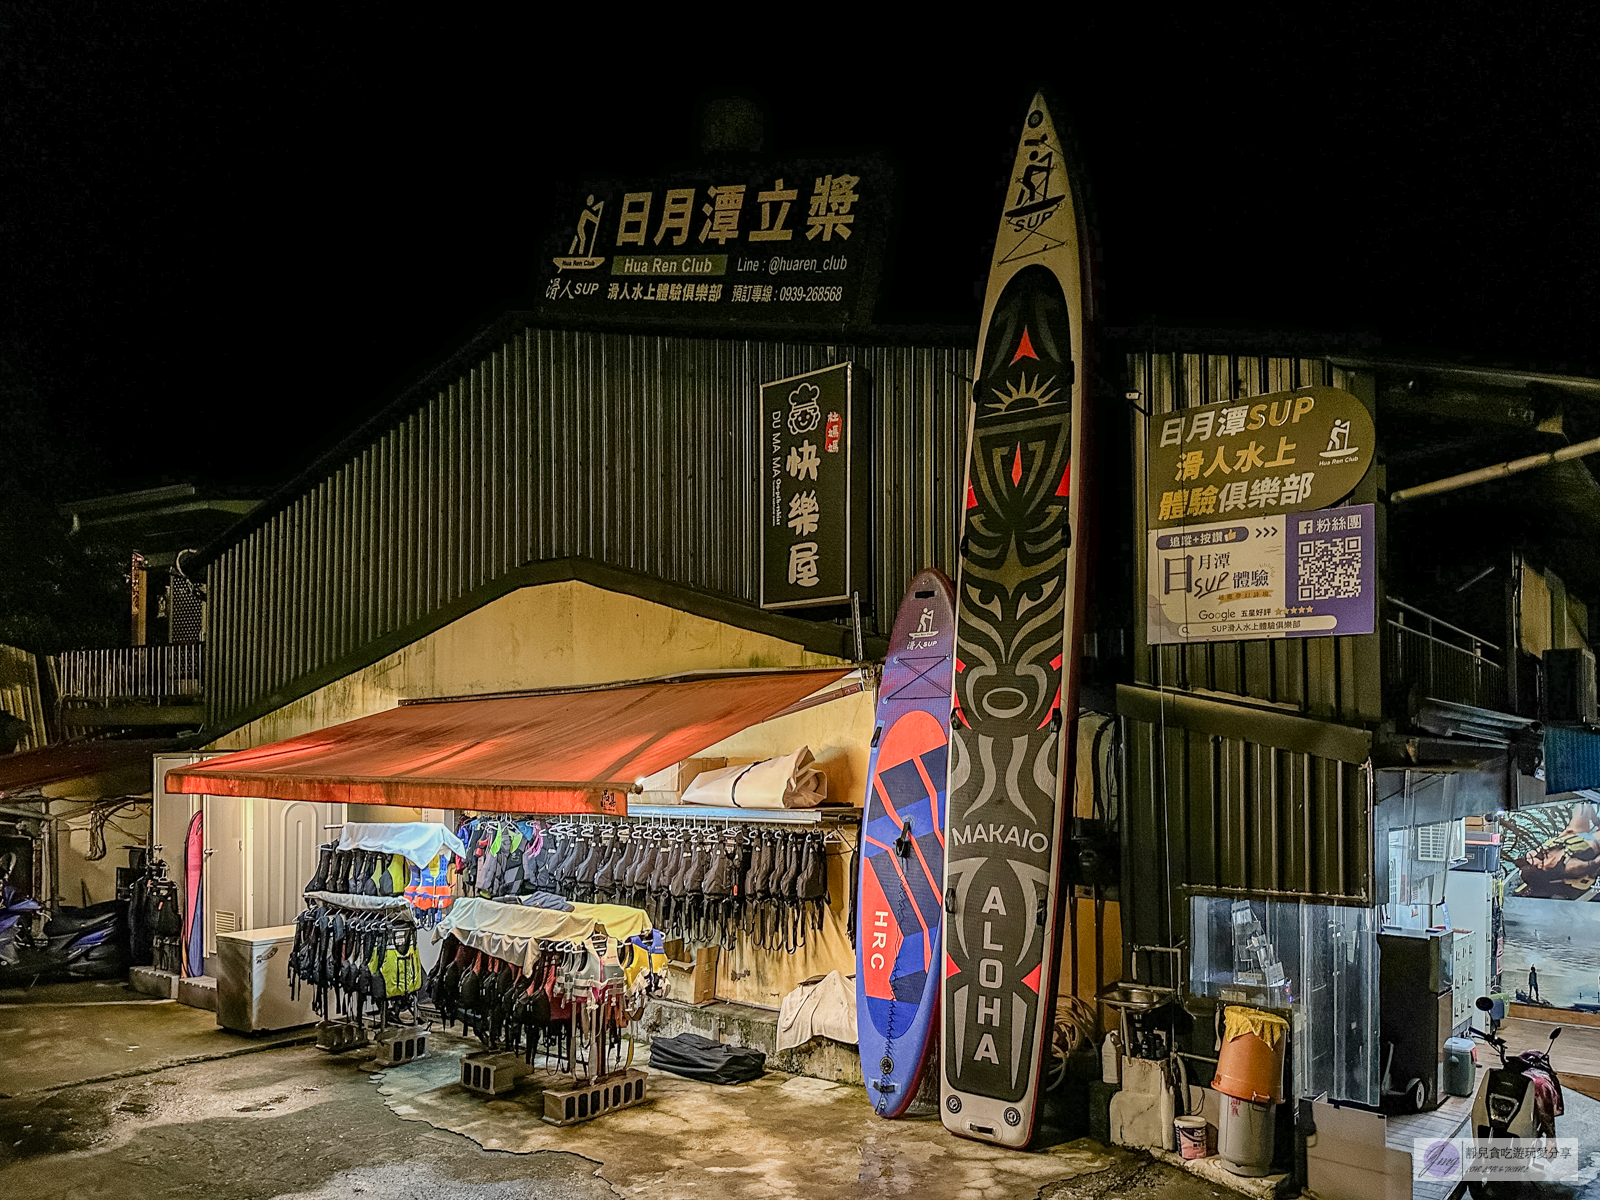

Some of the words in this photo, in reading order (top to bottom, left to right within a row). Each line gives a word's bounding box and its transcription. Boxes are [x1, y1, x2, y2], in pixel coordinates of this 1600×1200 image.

[616, 173, 860, 246] 日月潭立槳
[1014, 210, 1054, 233] SUP
[624, 258, 648, 272] Hua
[652, 258, 677, 272] Ren
[682, 257, 712, 272] Club
[737, 257, 759, 272] Line
[769, 255, 848, 275] @huaren_club
[545, 278, 599, 300] 滑人SUP
[607, 282, 723, 302] 滑人水上體驗俱樂部
[779, 286, 843, 301] 0939-268568
[772, 410, 781, 429] DU
[1159, 396, 1315, 448] 日月潭SUP
[772, 432, 781, 454] MA
[772, 456, 781, 478] MA
[1174, 436, 1297, 482] 滑人水上
[1158, 472, 1315, 521] 體驗俱樂部
[786, 440, 821, 587] 快樂屋
[1316, 514, 1362, 533] 粉絲團
[1233, 569, 1269, 589] 體驗
[1198, 608, 1236, 621] Google
[1241, 608, 1272, 618] 五星好評
[1211, 620, 1301, 633] SUP滑人水上體驗俱樂部
[951, 823, 1049, 853] MAKAIO
[870, 910, 889, 970] HRC
[973, 886, 1007, 1065] ALOHA
